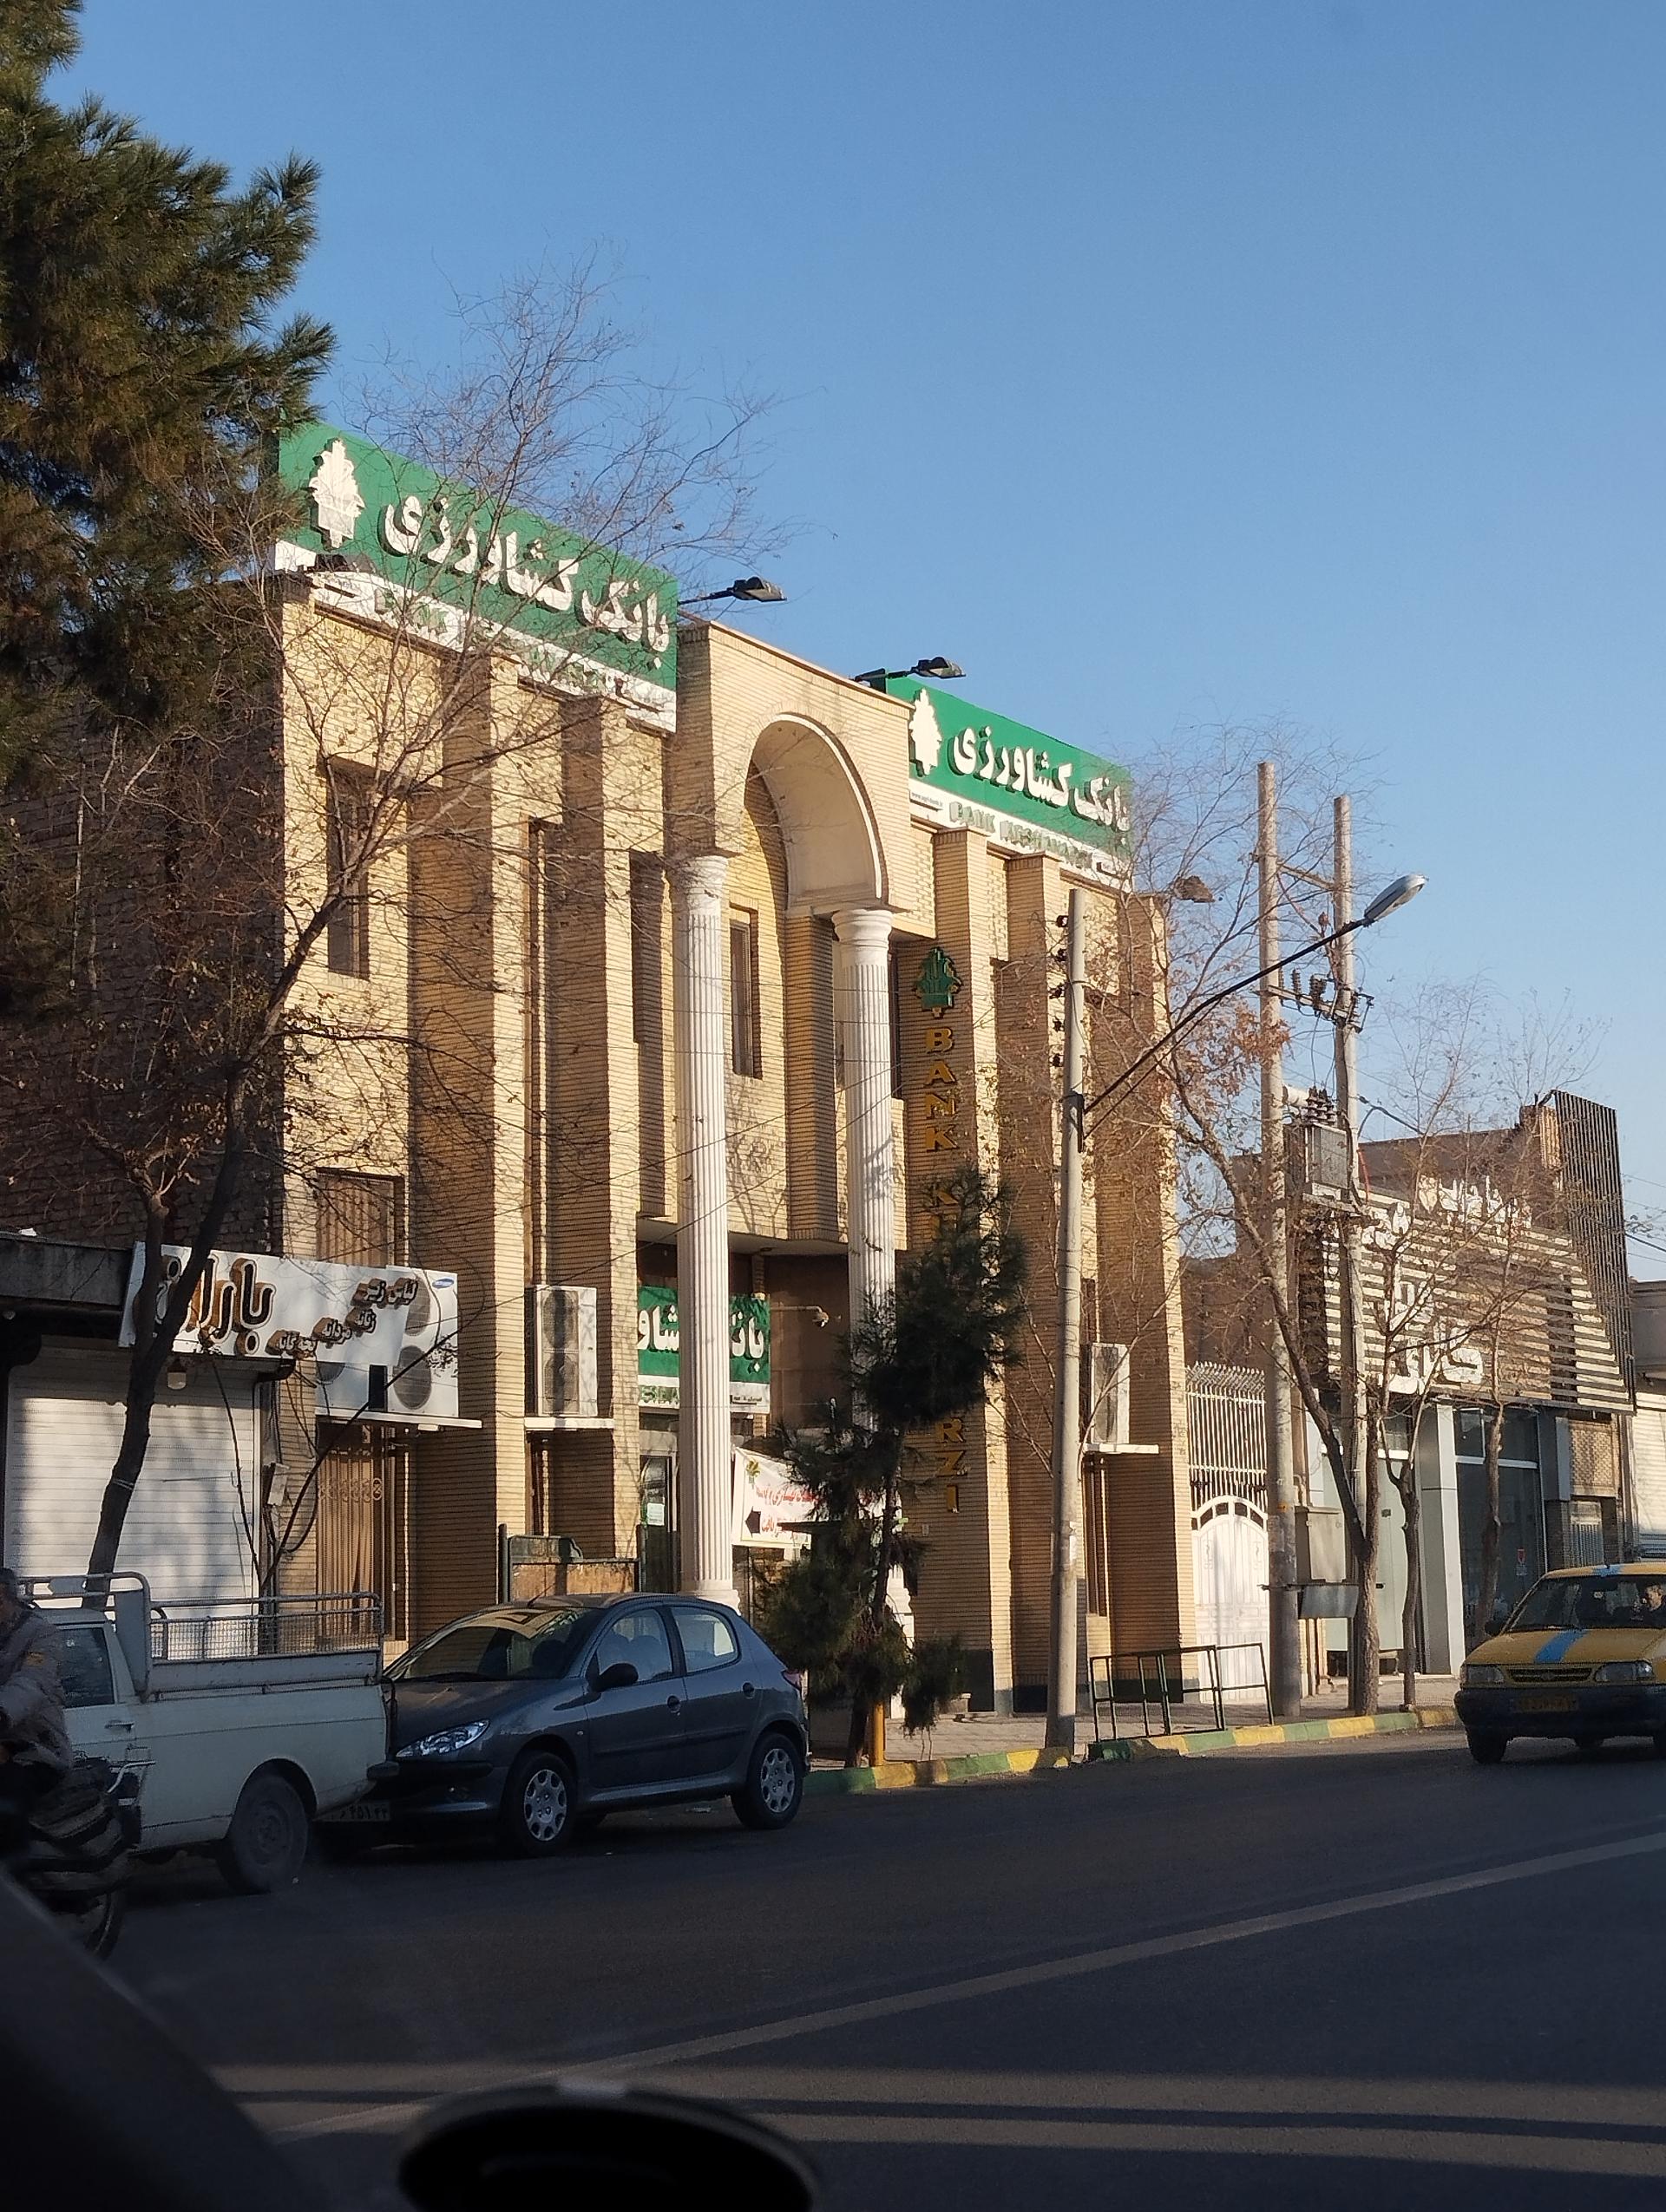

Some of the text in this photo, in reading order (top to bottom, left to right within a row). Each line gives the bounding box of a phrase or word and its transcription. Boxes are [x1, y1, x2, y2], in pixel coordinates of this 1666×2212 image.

[382, 494, 580, 611] کشاورزی
[580, 579, 670, 671] بانک
[952, 725, 1131, 846] بانک کشاورزی
[925, 1027, 959, 1153] BANK
[354, 1308, 377, 1334] زنانه
[387, 1279, 417, 1305] لباس
[322, 1318, 353, 1345] مردانه
[731, 1311, 765, 1373] بان
